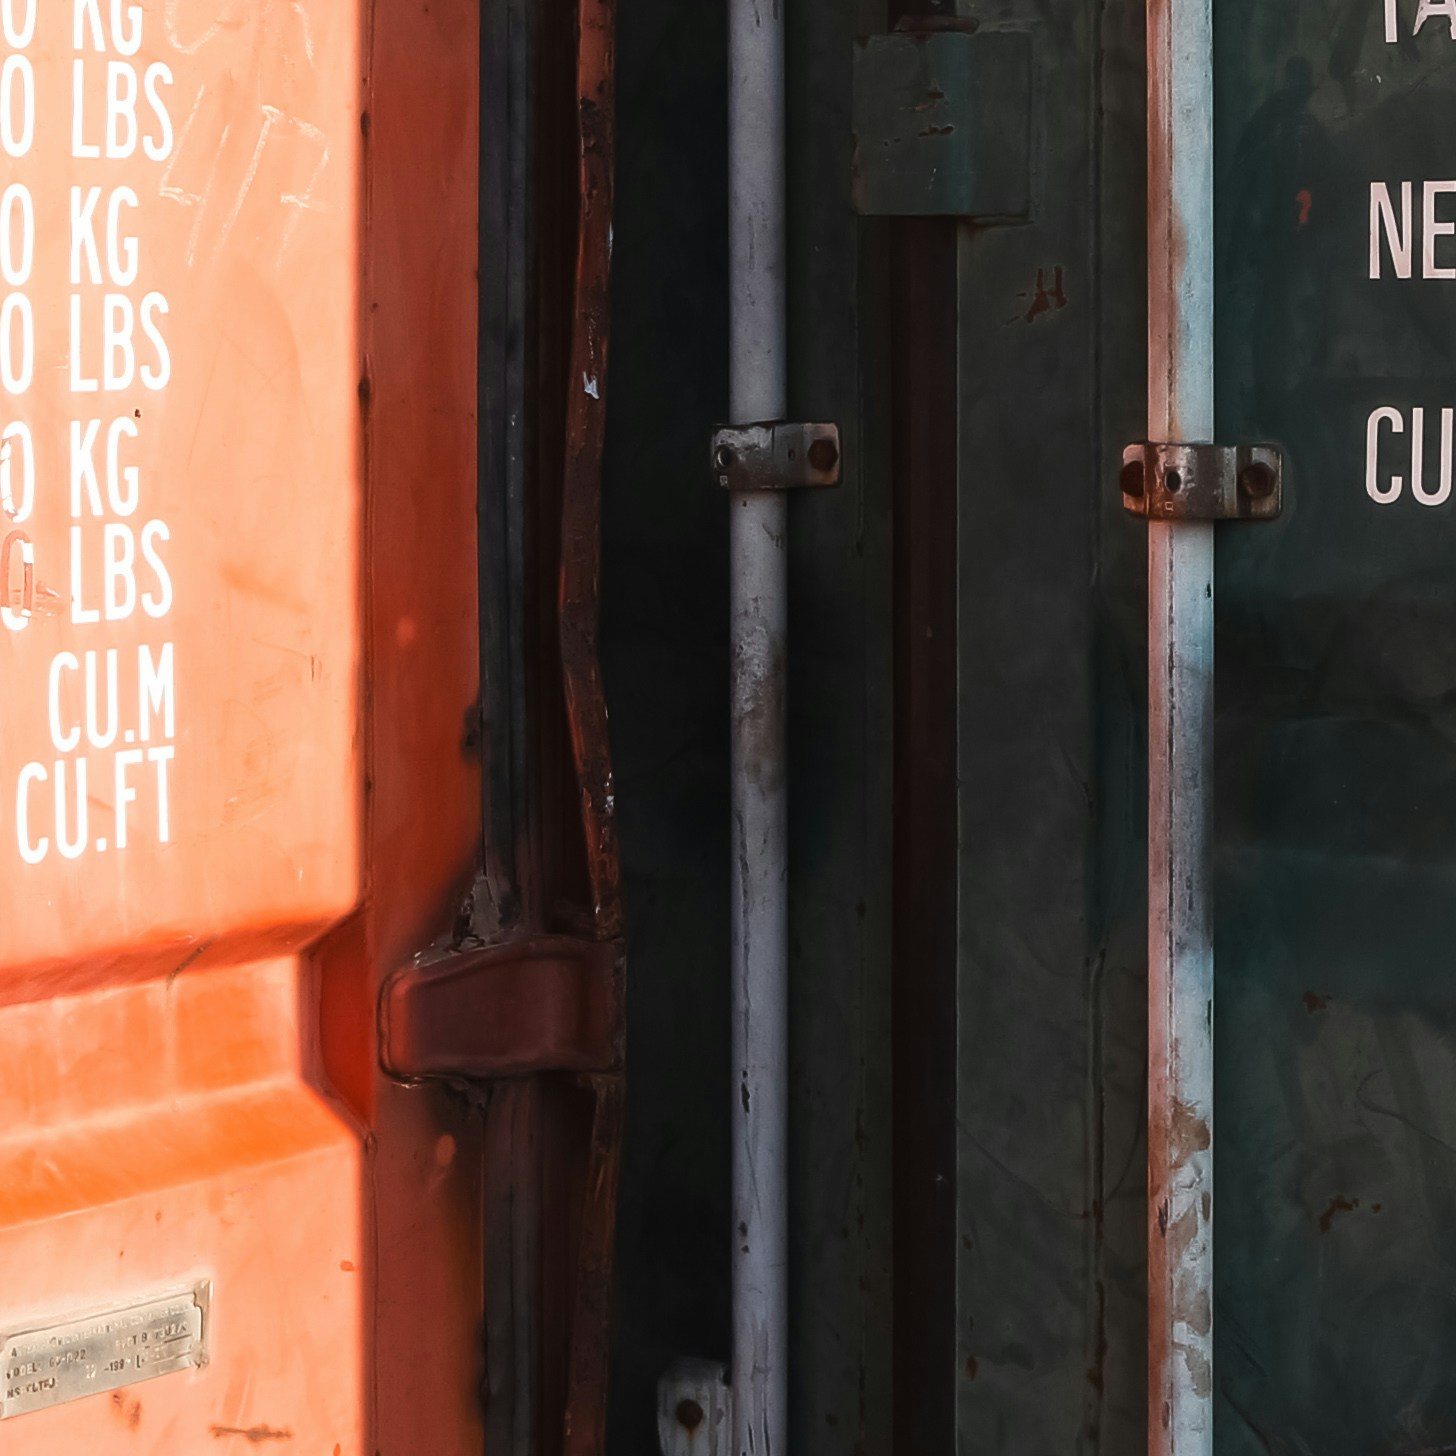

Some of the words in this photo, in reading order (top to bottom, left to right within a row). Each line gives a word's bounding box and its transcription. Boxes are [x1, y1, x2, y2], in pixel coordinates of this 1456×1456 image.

[74, 60, 172, 160] LBS
[72, 188, 137, 285] KG
[71, 293, 169, 390] LBS
[72, 418, 138, 516] KG
[72, 521, 171, 623] LBS
[48, 642, 175, 752] CU.M
[18, 747, 173, 863] CU.FT
